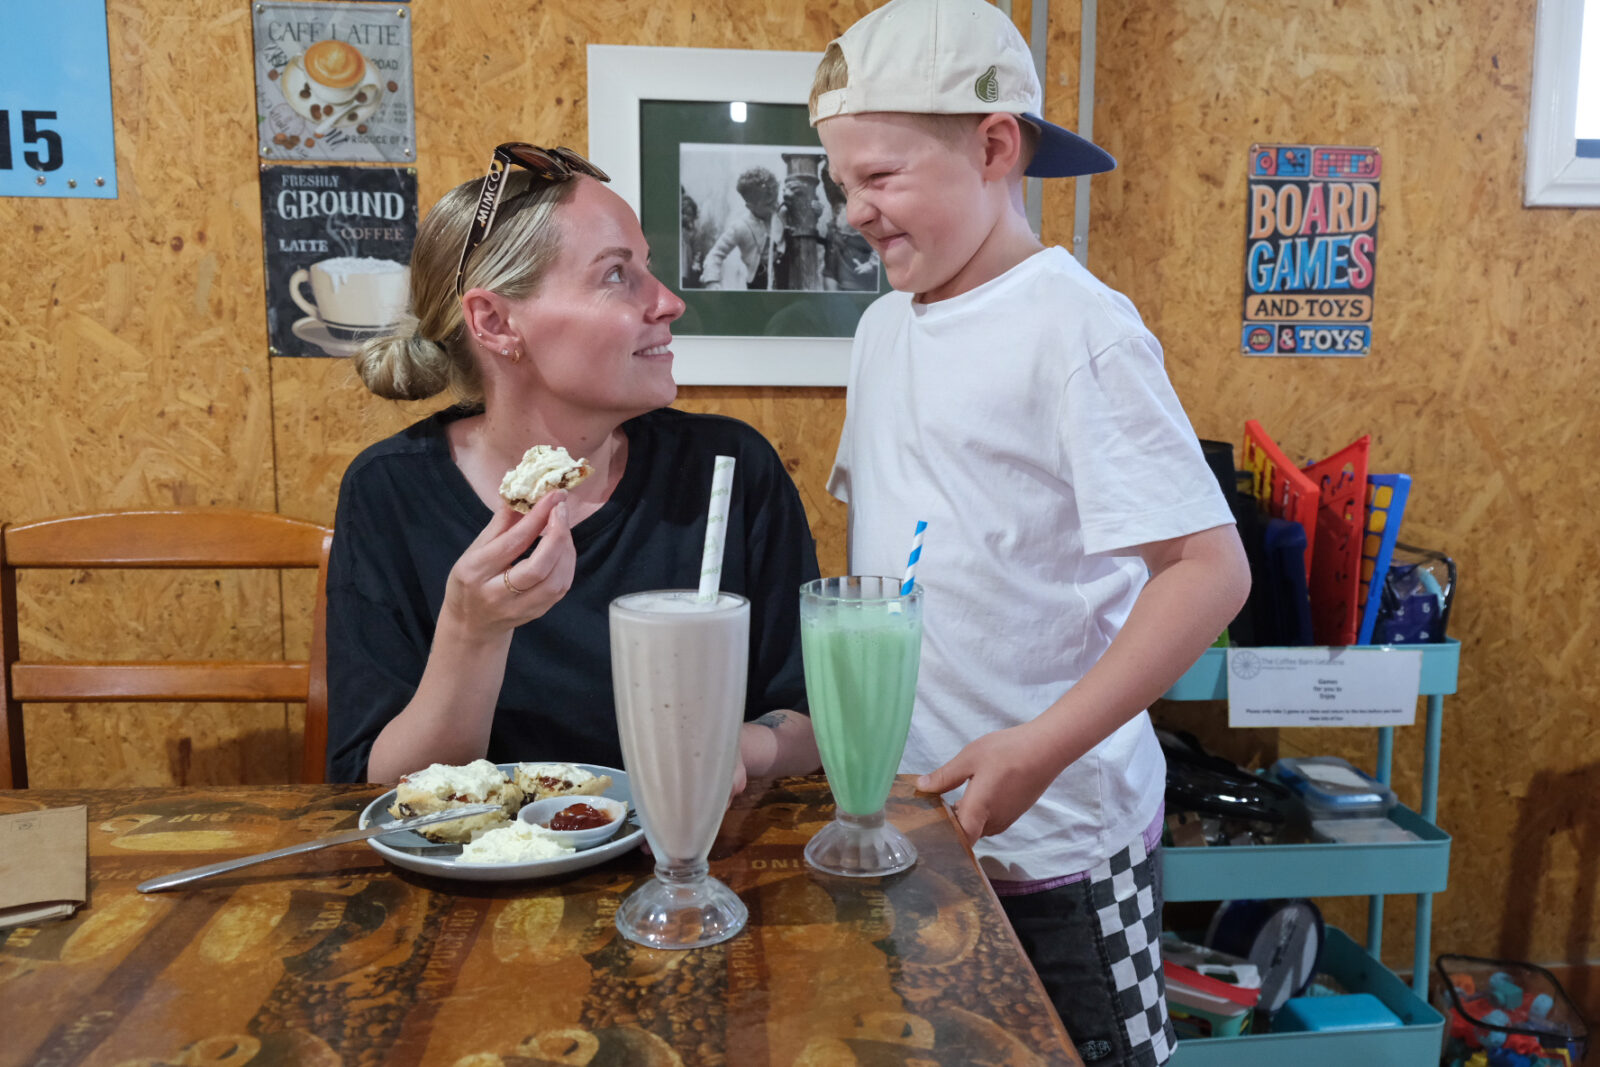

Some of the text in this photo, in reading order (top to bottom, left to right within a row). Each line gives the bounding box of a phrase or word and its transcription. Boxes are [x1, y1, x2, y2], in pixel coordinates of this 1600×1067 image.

[268, 17, 400, 46] CAFÉ LATTE
[281, 175, 340, 188] FRESHLY
[277, 189, 405, 220] GROUND
[477, 171, 501, 225] MIMCO
[1250, 182, 1378, 239] BOARD
[279, 239, 329, 252] LATTE
[340, 227, 404, 241] COFFEE
[1247, 233, 1375, 293] GAMES
[1254, 299, 1364, 317] AND TOYS
[1279, 328, 1365, 350] & TOYS
